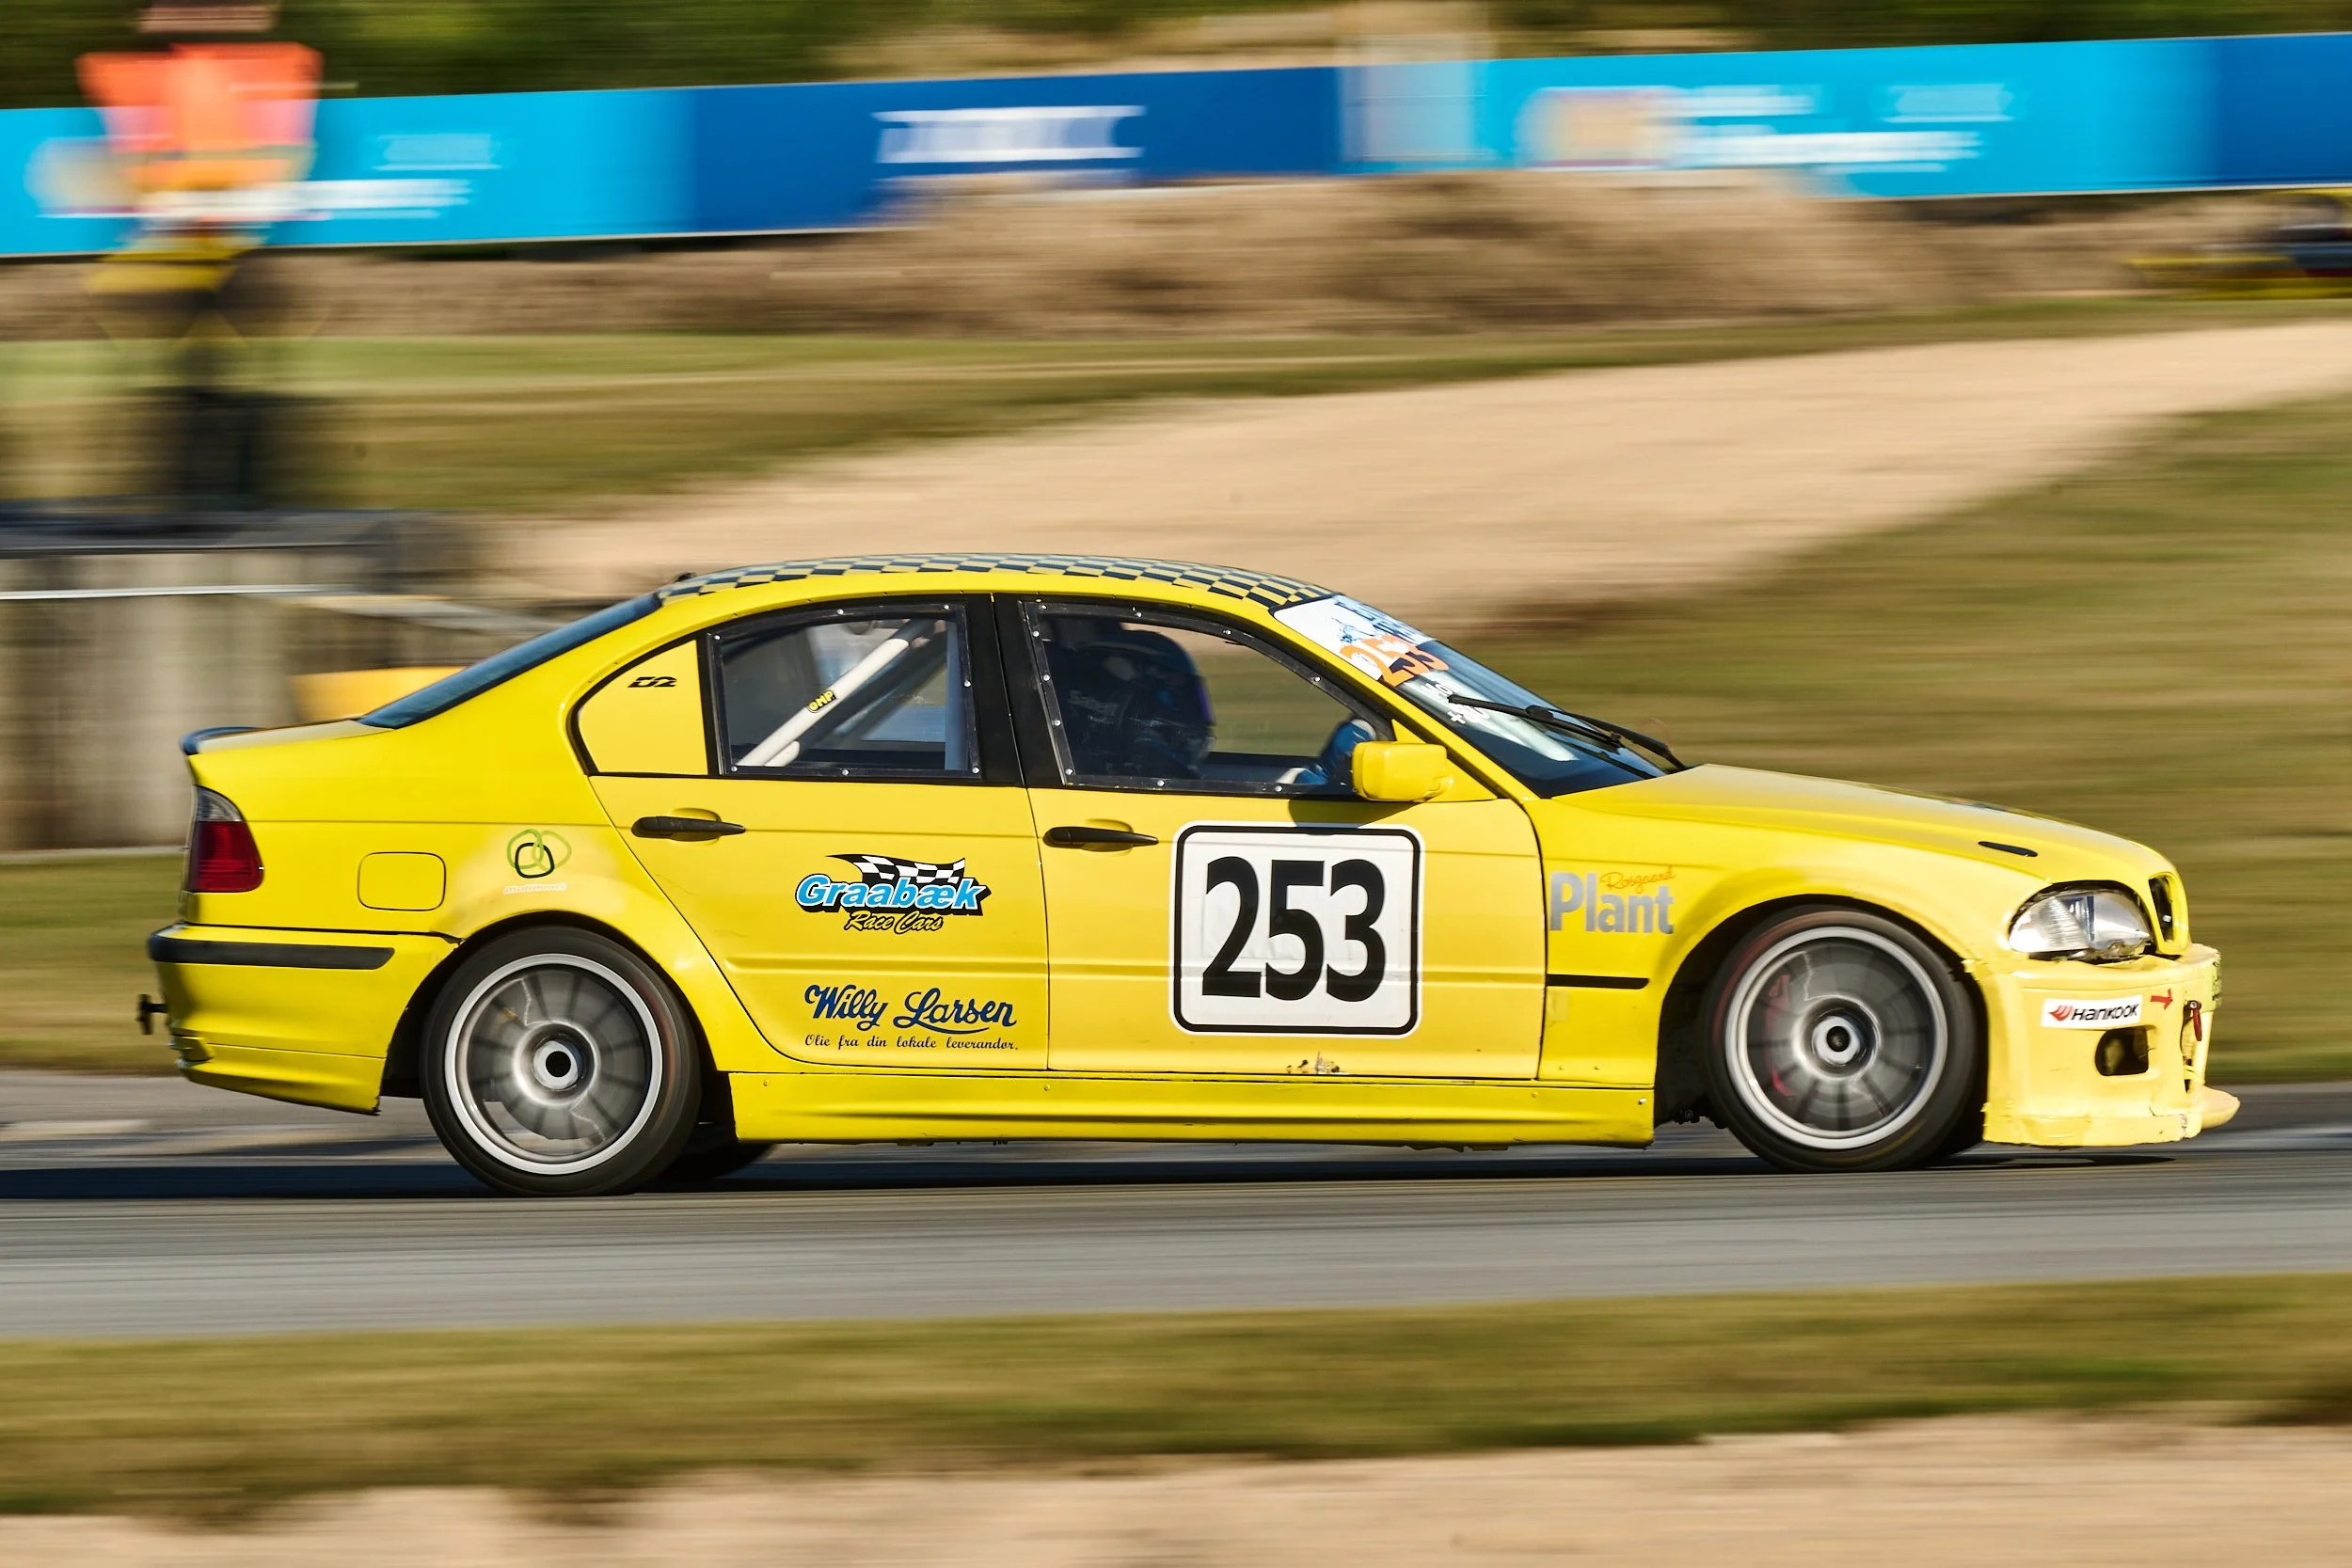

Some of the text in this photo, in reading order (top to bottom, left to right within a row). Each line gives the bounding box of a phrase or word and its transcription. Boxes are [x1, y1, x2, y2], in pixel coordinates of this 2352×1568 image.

[1340, 634, 1449, 688] 253
[808, 689, 835, 711] OMP
[796, 874, 990, 911] Graabæk
[1549, 872, 1674, 934] Plant
[844, 911, 944, 934] Race Cars
[1201, 855, 1386, 1002] 253
[804, 984, 1017, 1035] Willy Larsen
[804, 1034, 831, 1047] Olie
[838, 1035, 859, 1050] fra
[866, 1036, 887, 1048] din
[896, 1036, 937, 1049] lokale
